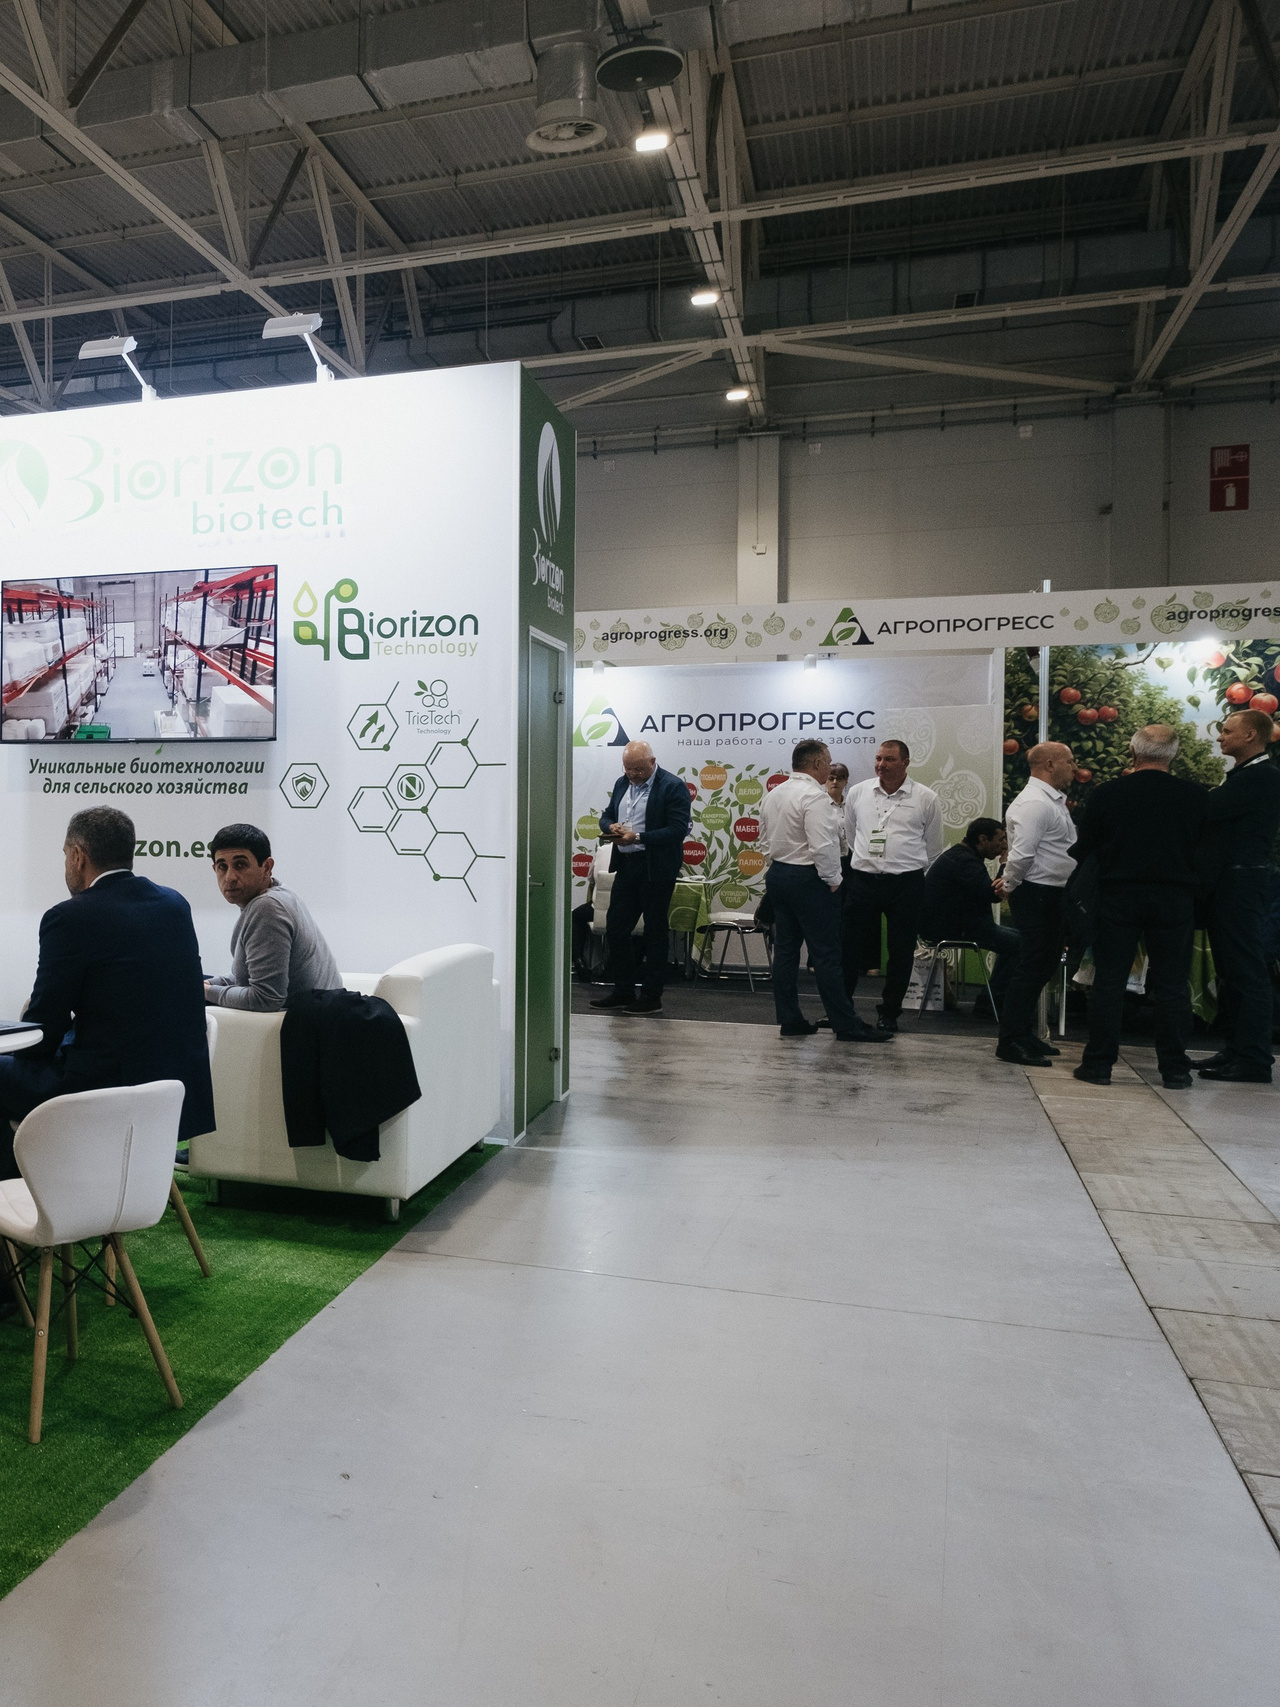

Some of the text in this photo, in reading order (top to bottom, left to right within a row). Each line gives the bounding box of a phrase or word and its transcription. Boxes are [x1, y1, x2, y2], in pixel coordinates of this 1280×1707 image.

[63, 434, 343, 524] Biorizon
[192, 490, 343, 536] biotech
[547, 586, 564, 617] biotech
[337, 608, 479, 660] Biorizon
[601, 626, 728, 643] agroprogress.org
[877, 615, 1054, 635] АГРОПРОГРЕСС
[374, 639, 478, 658] Technology
[640, 711, 876, 732] АГРОПРОГРЕСС
[416, 728, 452, 736] Technology
[678, 738, 711, 747] наша
[716, 736, 762, 748] работа
[829, 736, 876, 745] забота
[29, 757, 265, 774] Уникальные биотехнологии
[42, 778, 249, 795] для сельского хозяйства
[738, 788, 761, 796] ДЕЛОР
